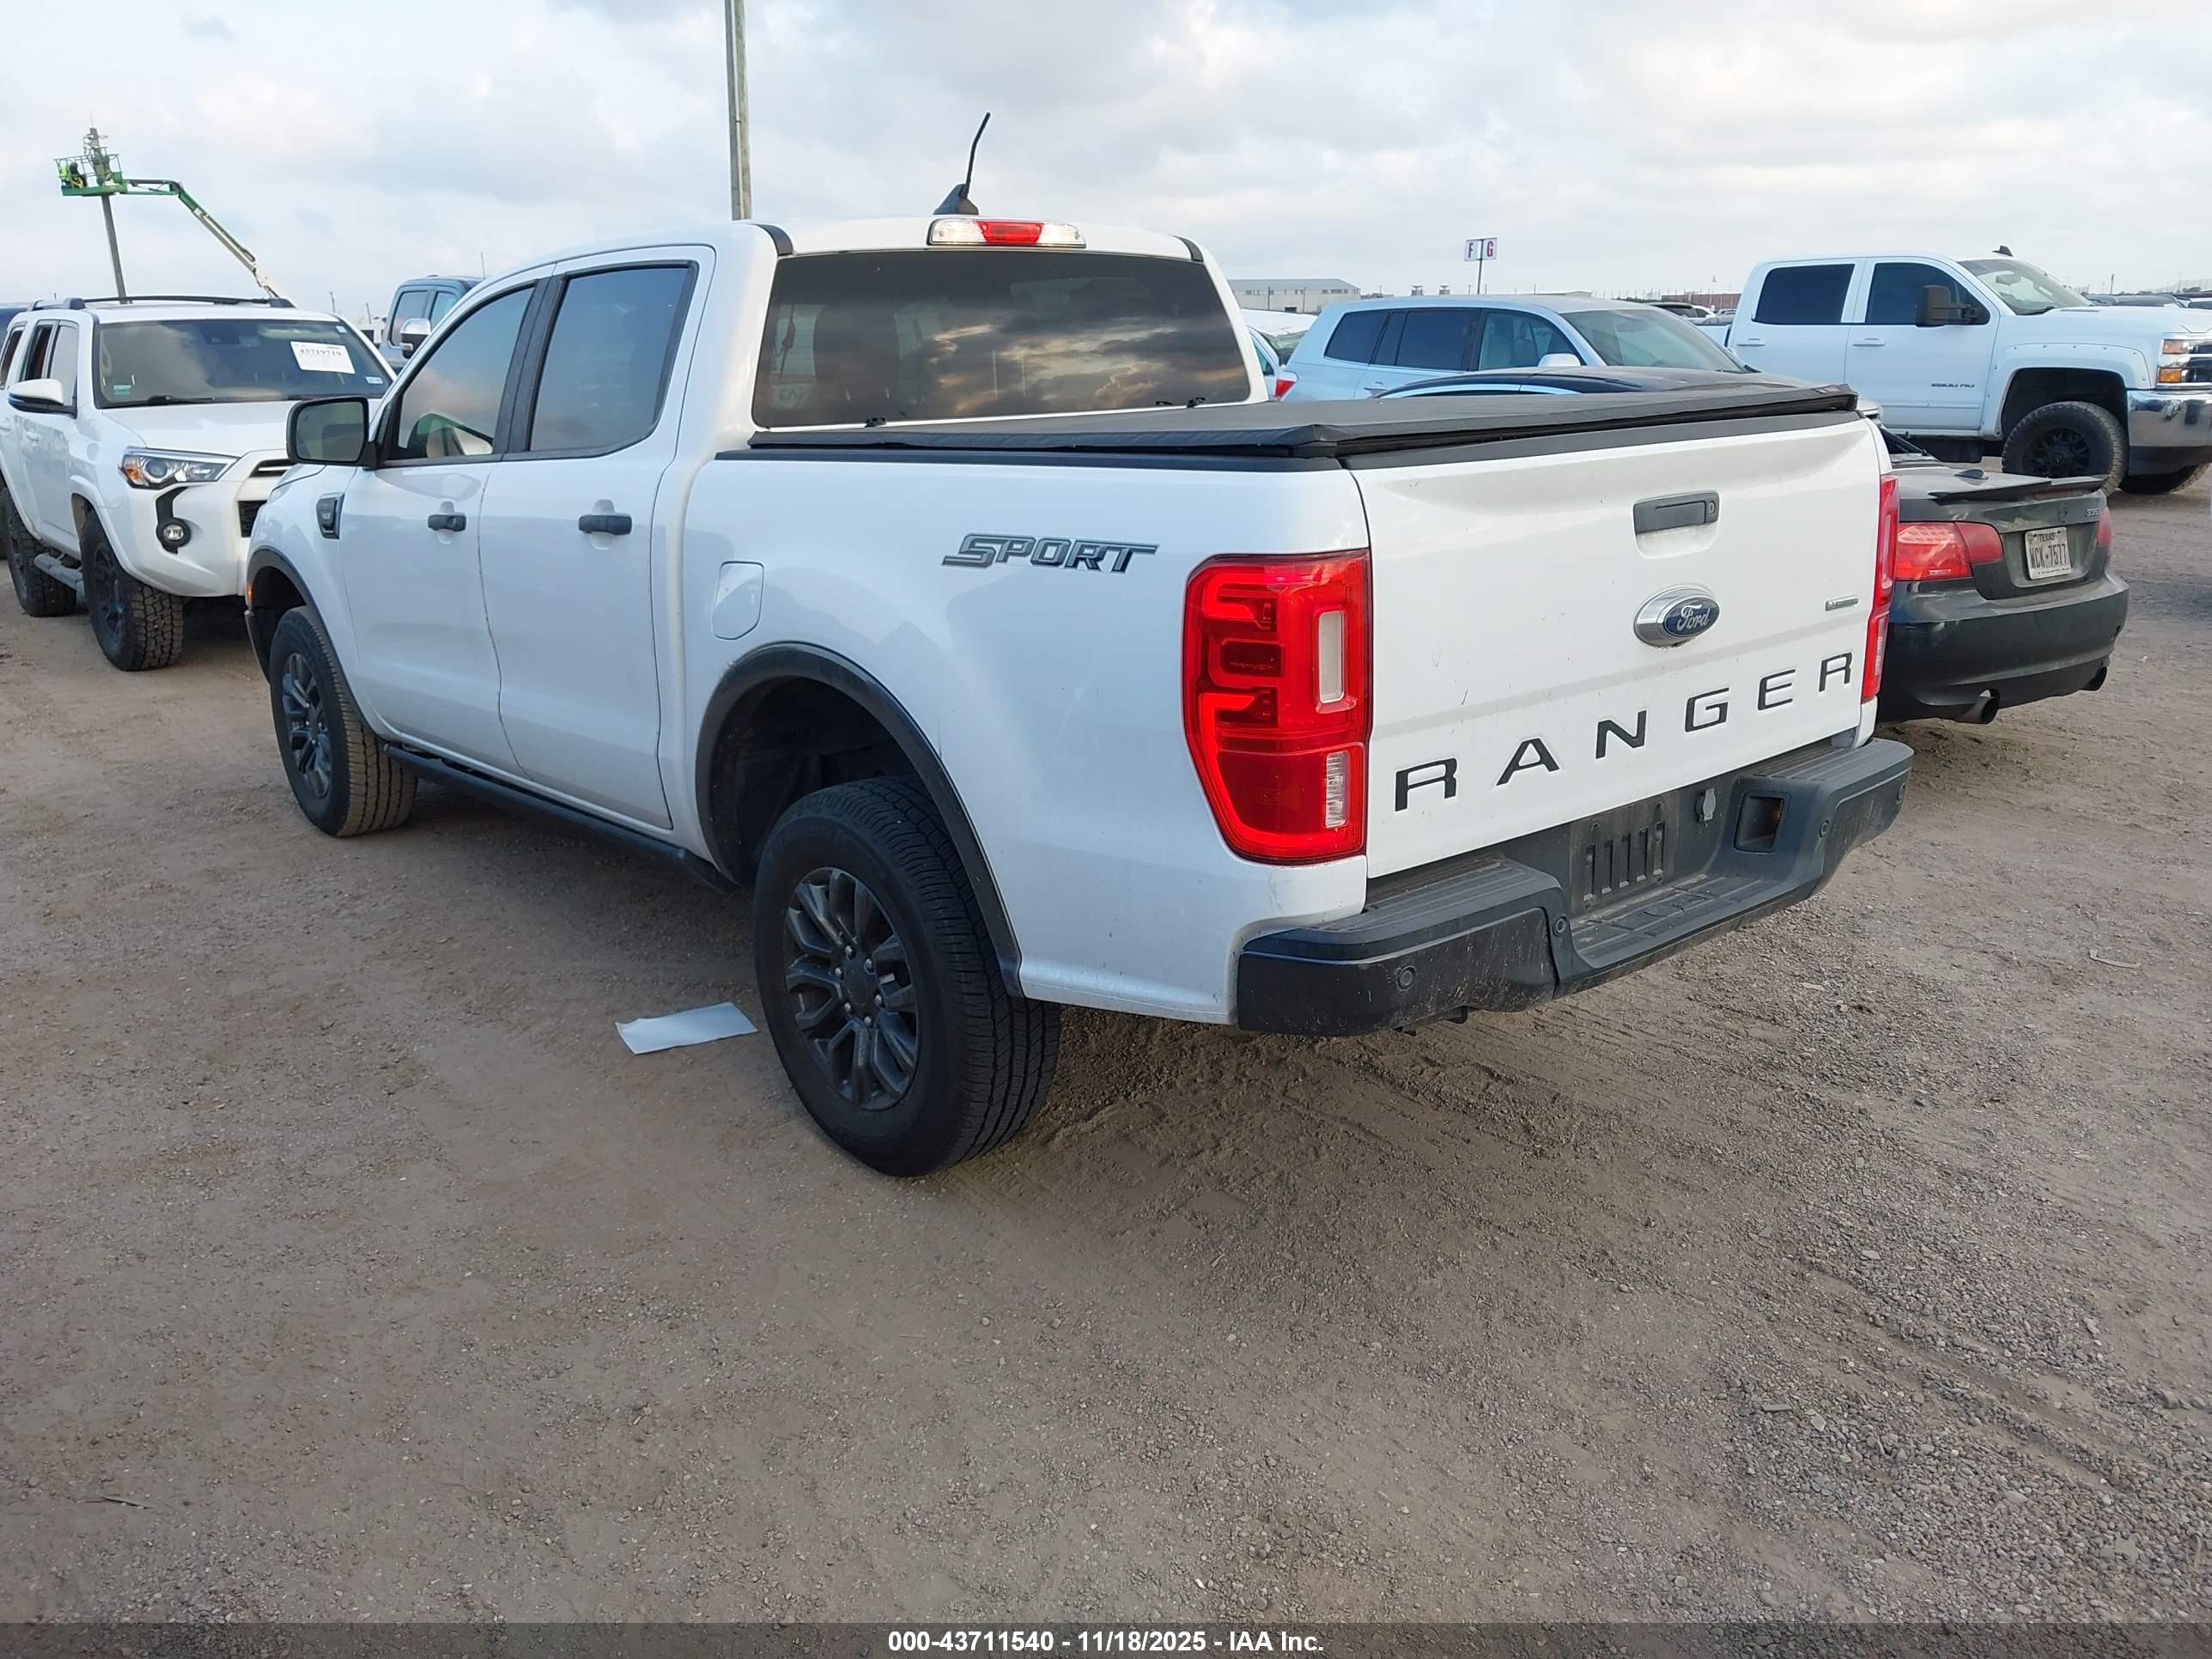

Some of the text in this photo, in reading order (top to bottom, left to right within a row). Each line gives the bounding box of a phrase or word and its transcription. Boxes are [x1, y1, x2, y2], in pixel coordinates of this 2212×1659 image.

[1468, 242, 1474, 258] F
[1486, 240, 1494, 258] G
[2038, 532, 2055, 543] TEXAS
[941, 533, 1160, 574] SPORT
[1676, 604, 1711, 631] Ford
[1394, 652, 1853, 812] RANGER
